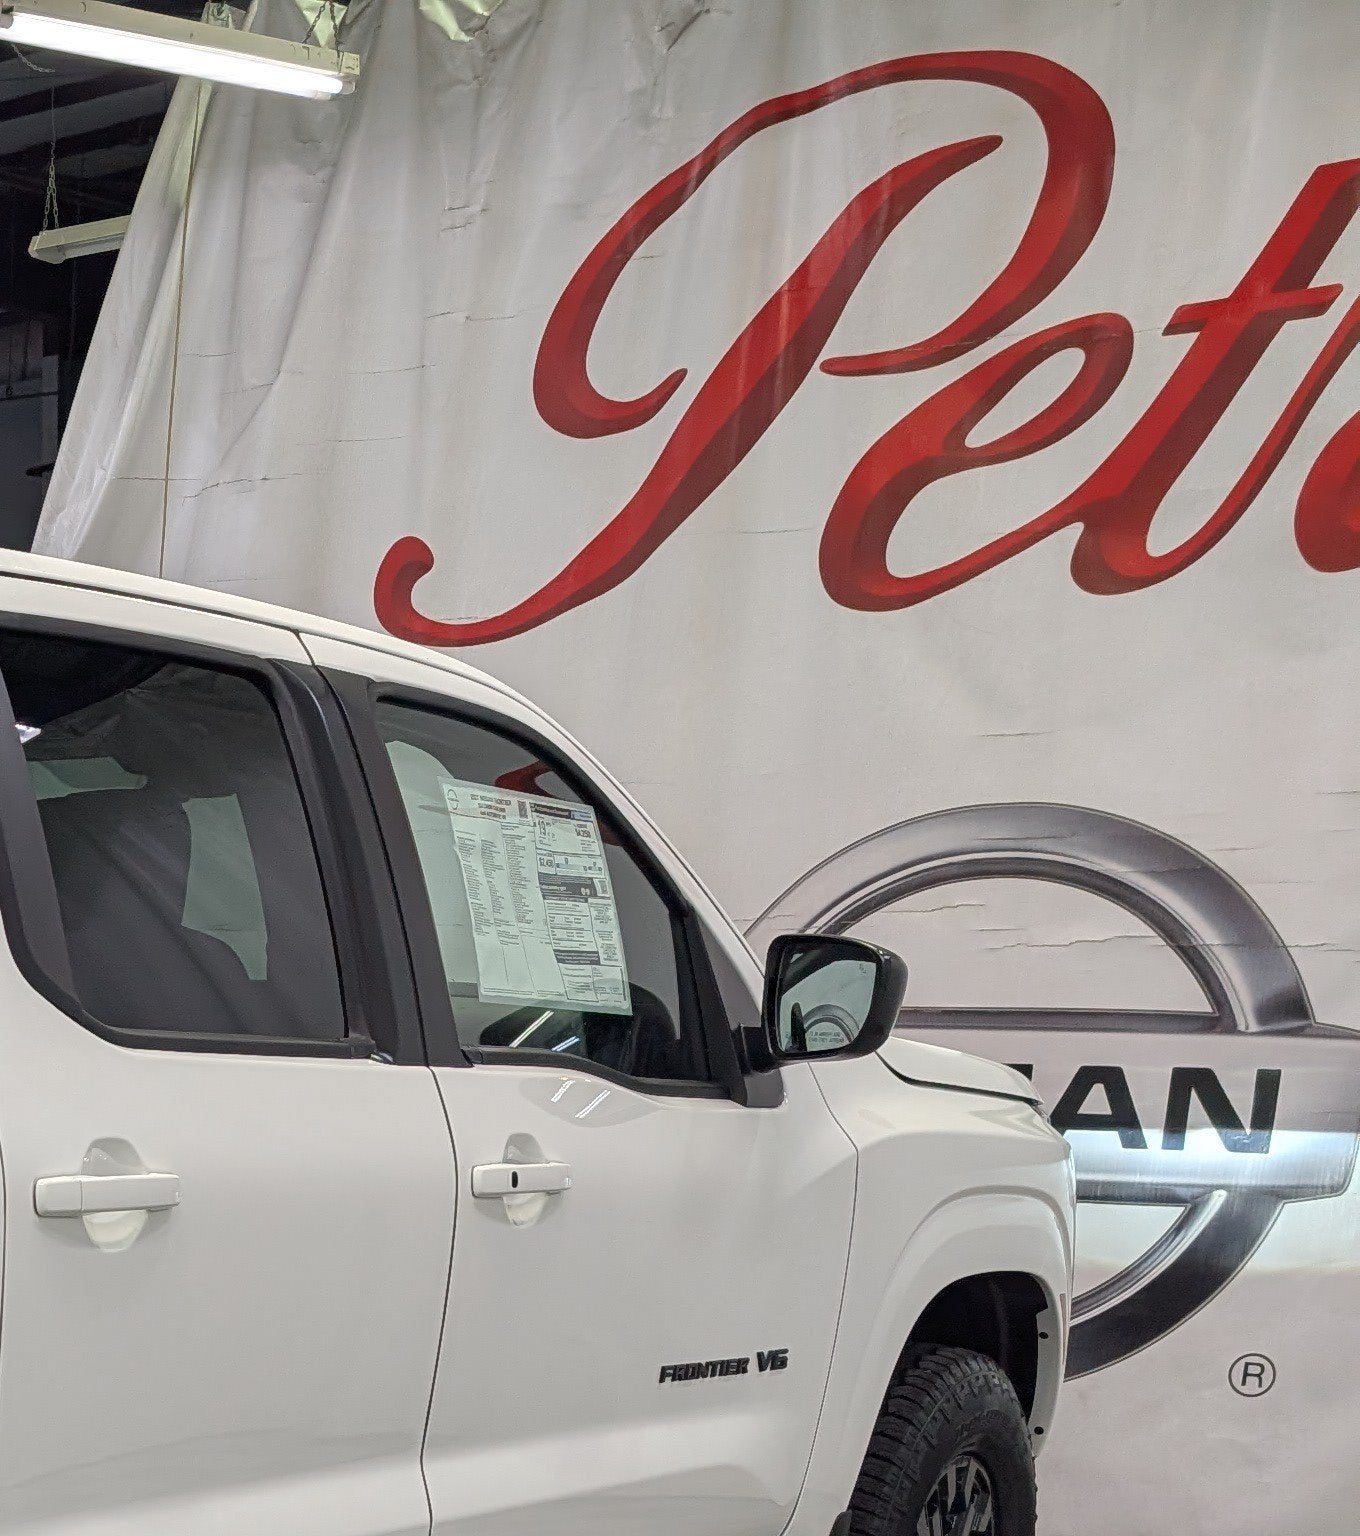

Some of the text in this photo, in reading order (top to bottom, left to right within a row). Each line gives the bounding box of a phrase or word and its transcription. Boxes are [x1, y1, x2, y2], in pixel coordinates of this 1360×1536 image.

[374, 50, 1360, 647] Pet
[658, 1348, 789, 1384] FRONTIER V6
